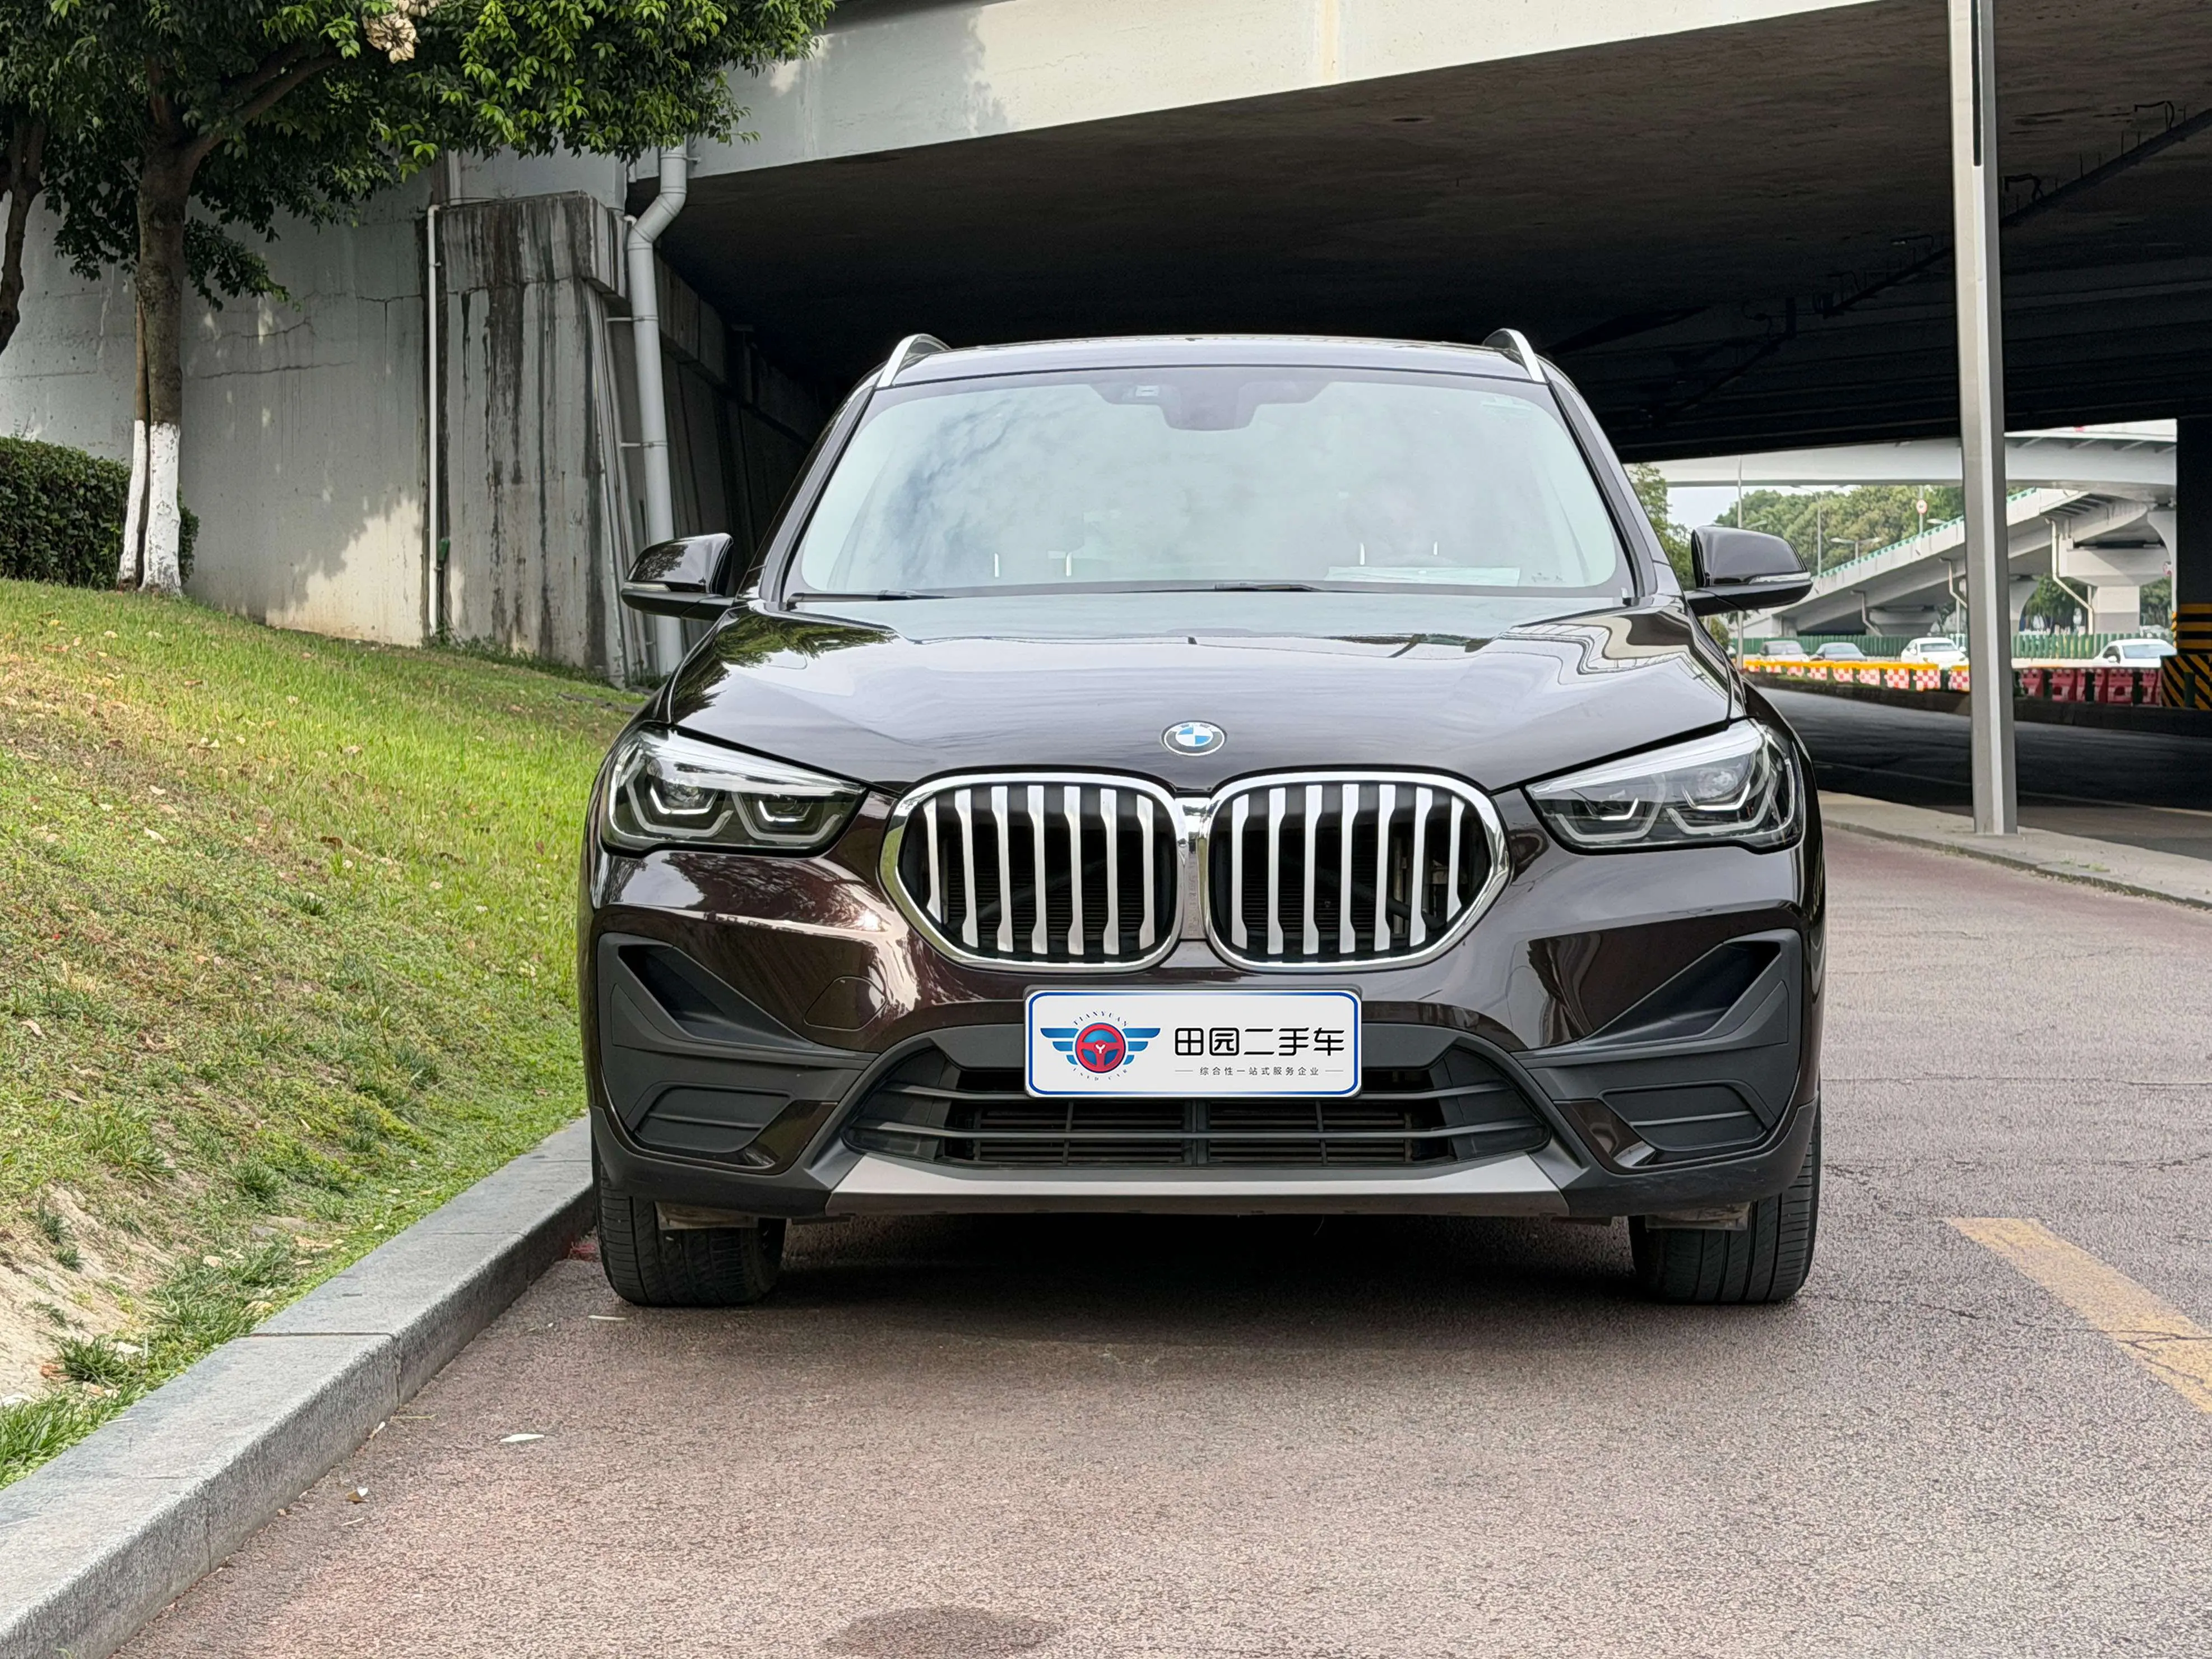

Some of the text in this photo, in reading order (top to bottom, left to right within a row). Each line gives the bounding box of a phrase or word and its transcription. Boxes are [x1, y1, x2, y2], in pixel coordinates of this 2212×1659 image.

[1175, 1027, 1344, 1056] 田园二手车
[1200, 1067, 1318, 1076] 综合性一站式服务企业
